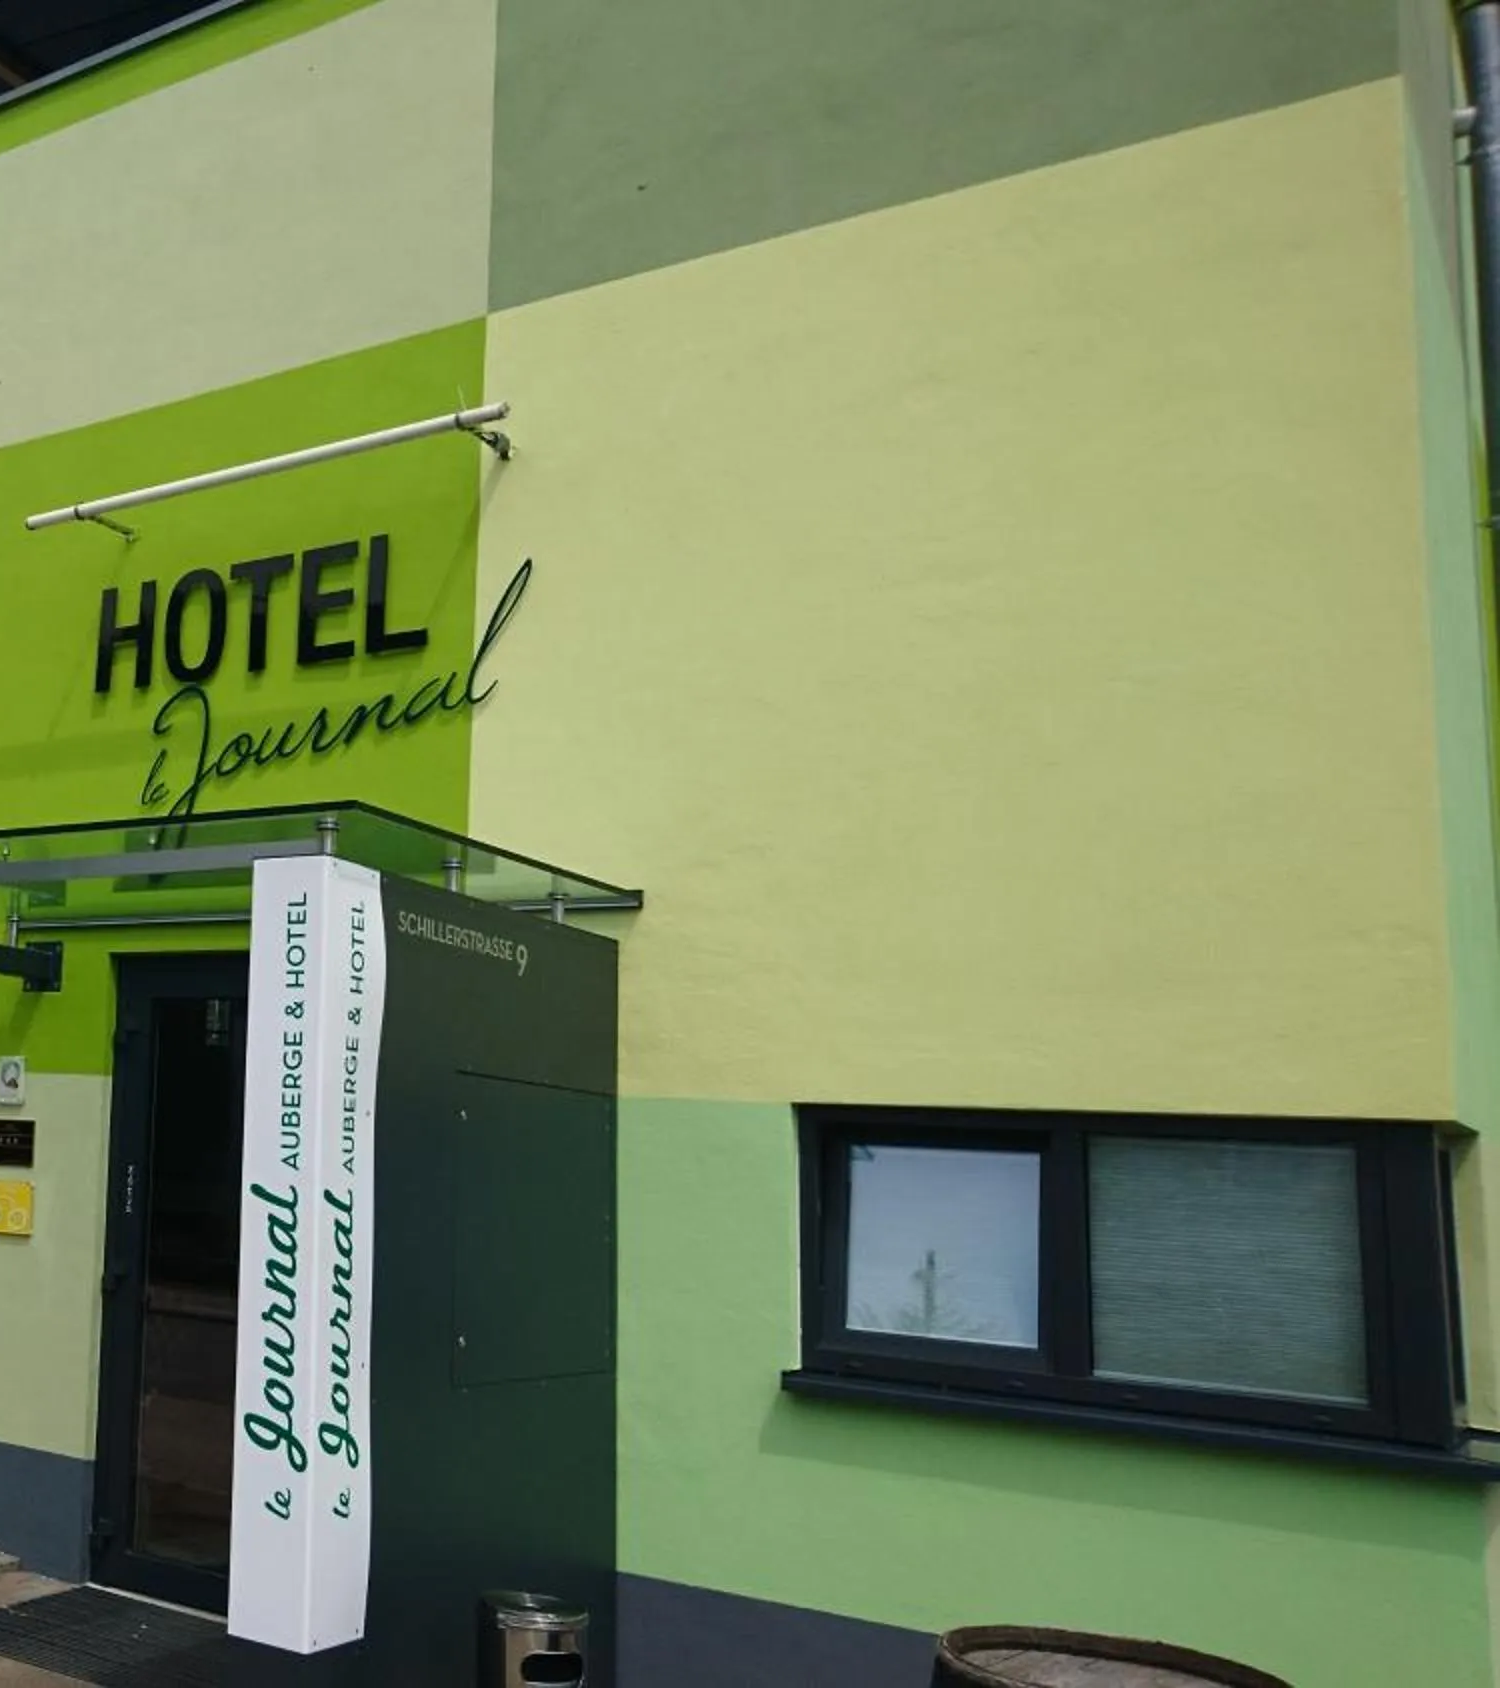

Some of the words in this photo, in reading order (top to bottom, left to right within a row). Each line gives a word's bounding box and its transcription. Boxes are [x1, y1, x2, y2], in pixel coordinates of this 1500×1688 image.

[95, 534, 428, 694] HOTEL
[148, 557, 532, 880] Journal
[141, 748, 170, 805] le
[285, 892, 308, 989] HOTEL
[351, 901, 367, 995] HOTEL
[398, 911, 514, 962] SCHILLERSTRASSE
[515, 944, 530, 977] 9
[283, 1000, 304, 1020] &
[347, 1006, 362, 1026] &
[280, 1030, 304, 1171] AUBERGE
[341, 1036, 360, 1175] AUBERGE
[243, 1183, 308, 1473] Journal
[318, 1188, 360, 1469] Journal
[265, 1487, 292, 1521] le
[333, 1487, 351, 1519] le
